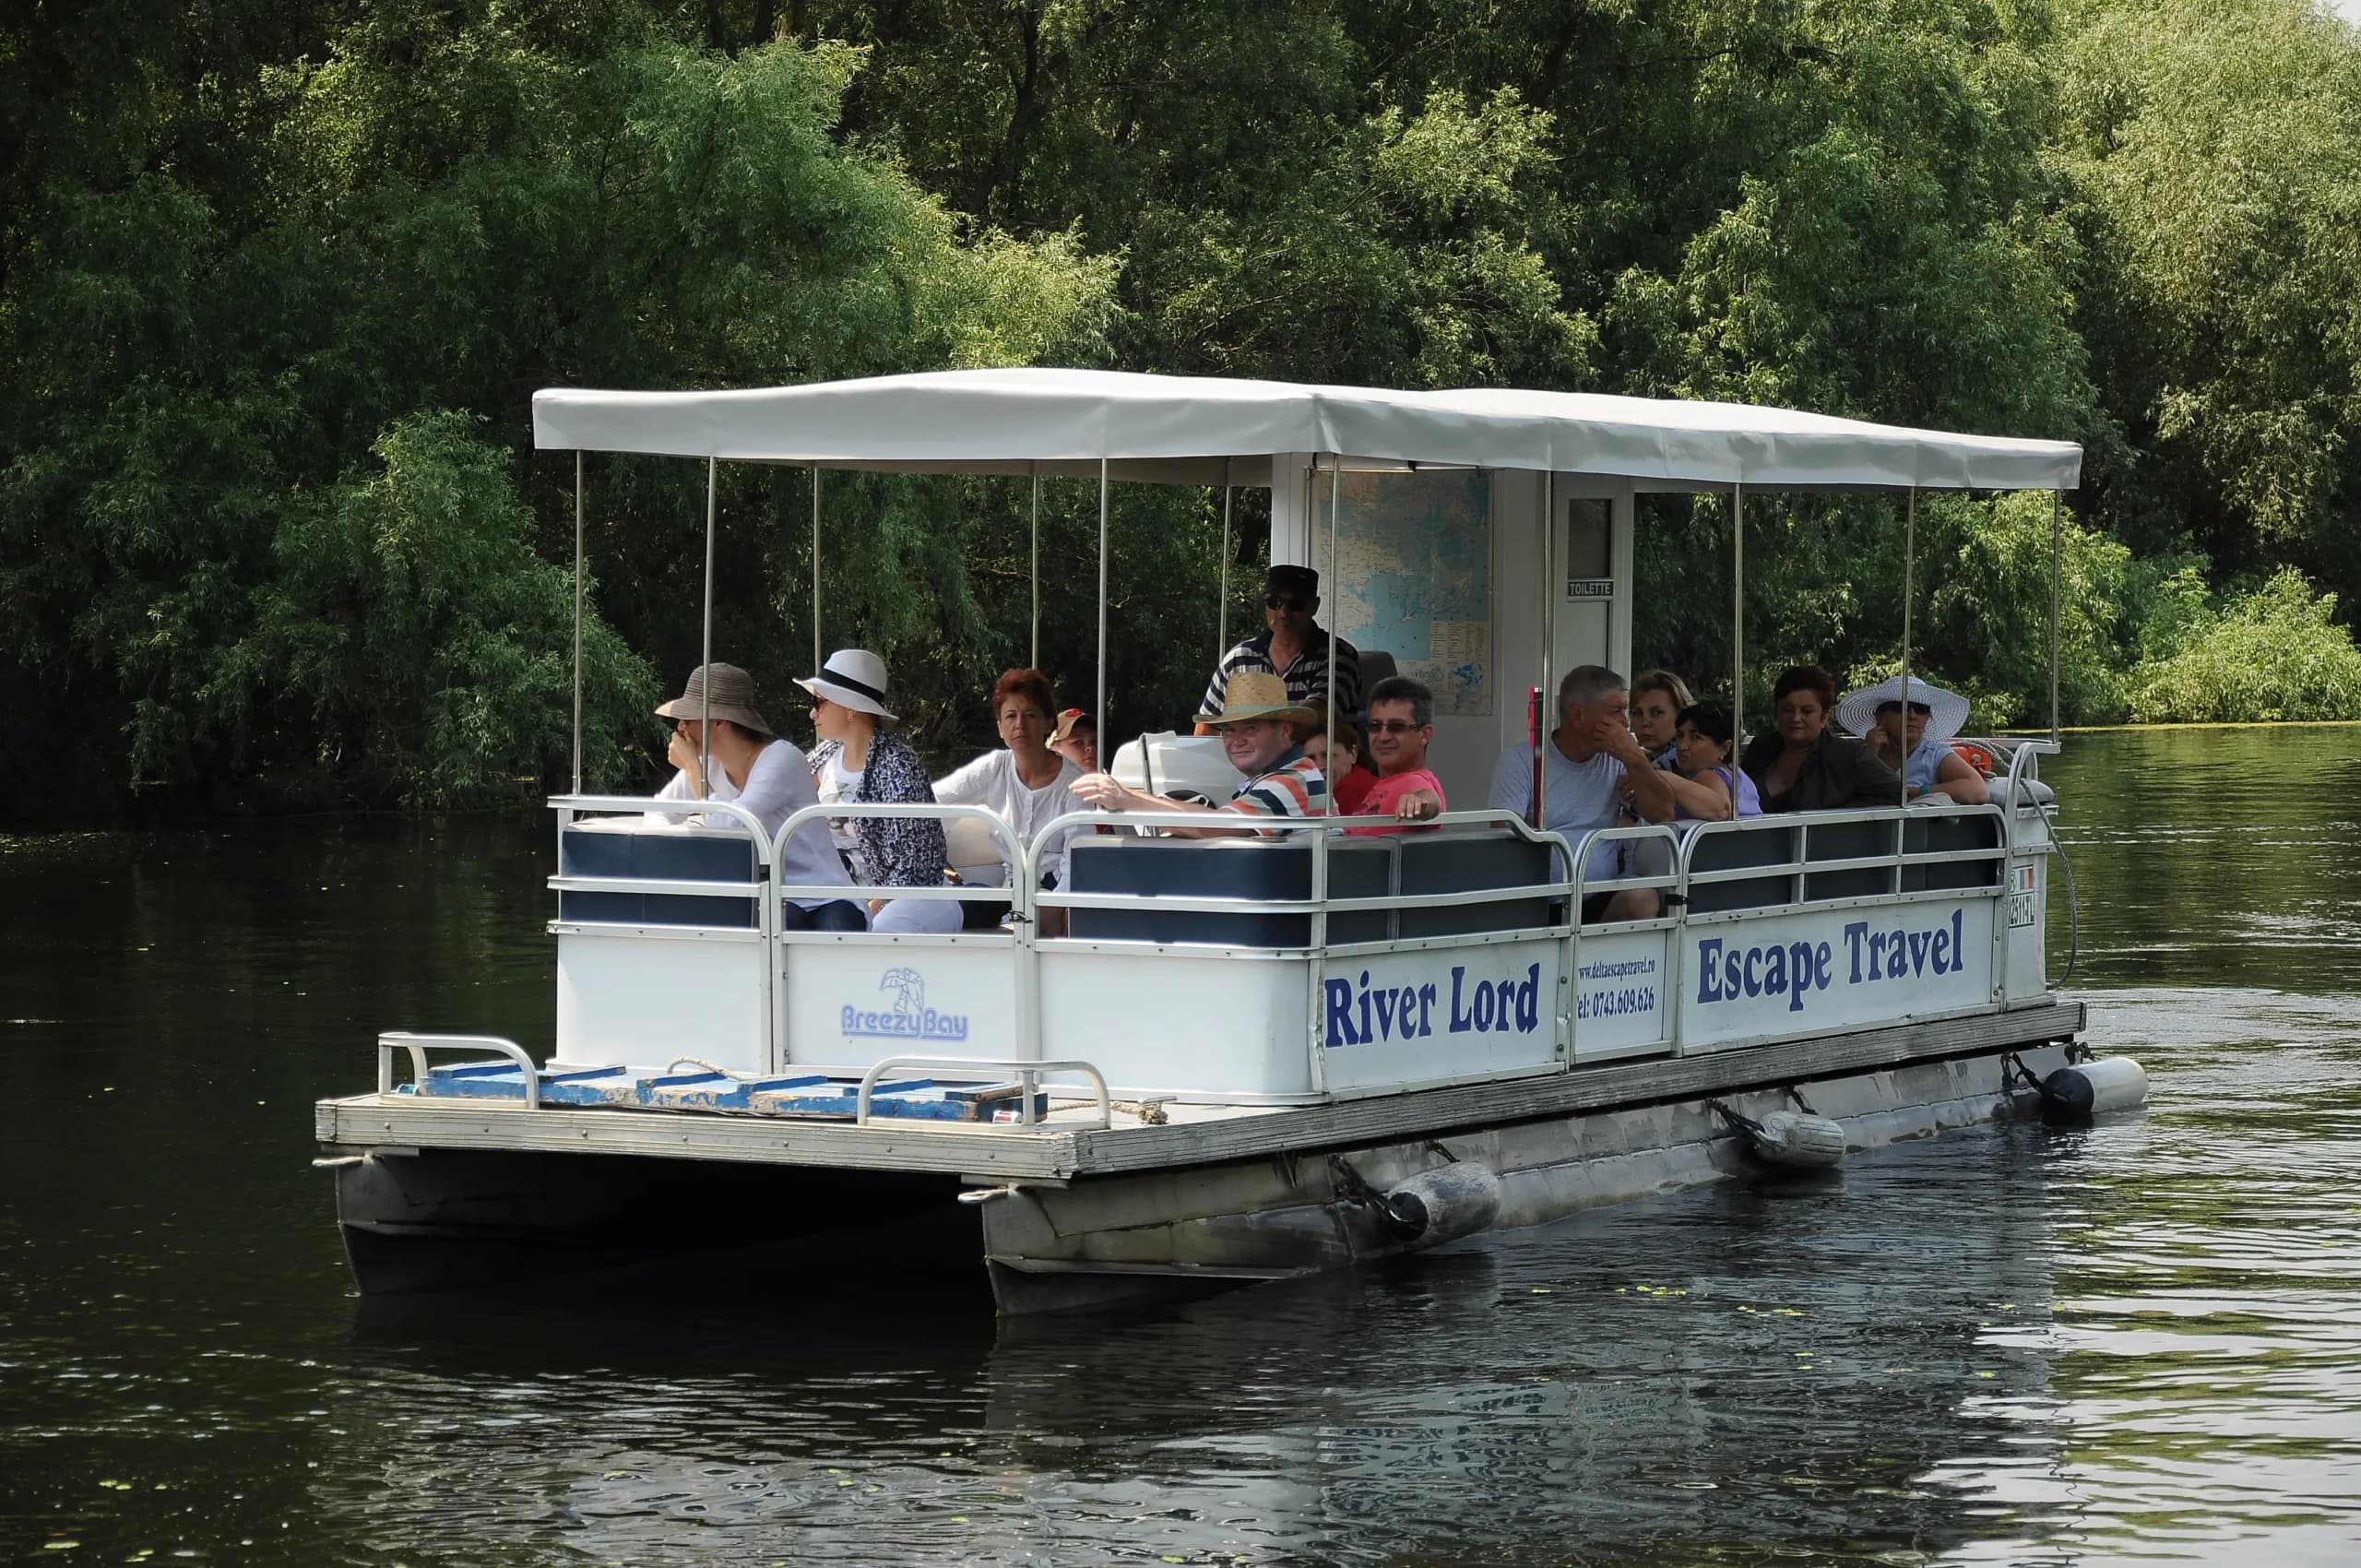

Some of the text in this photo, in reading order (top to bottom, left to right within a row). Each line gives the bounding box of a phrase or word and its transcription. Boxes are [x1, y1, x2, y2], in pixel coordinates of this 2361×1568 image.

[1570, 582, 1610, 595] TOILETTE
[2009, 896, 2035, 924] 2511-TL
[1578, 956, 1655, 981] ww.deltaescapetravel.ro
[1697, 909, 1963, 1012] Escape Travel
[1324, 962, 1540, 1048] River Lord
[1576, 986, 1655, 1020] el: 0743.609.626
[841, 1004, 968, 1041] BreezyBay
